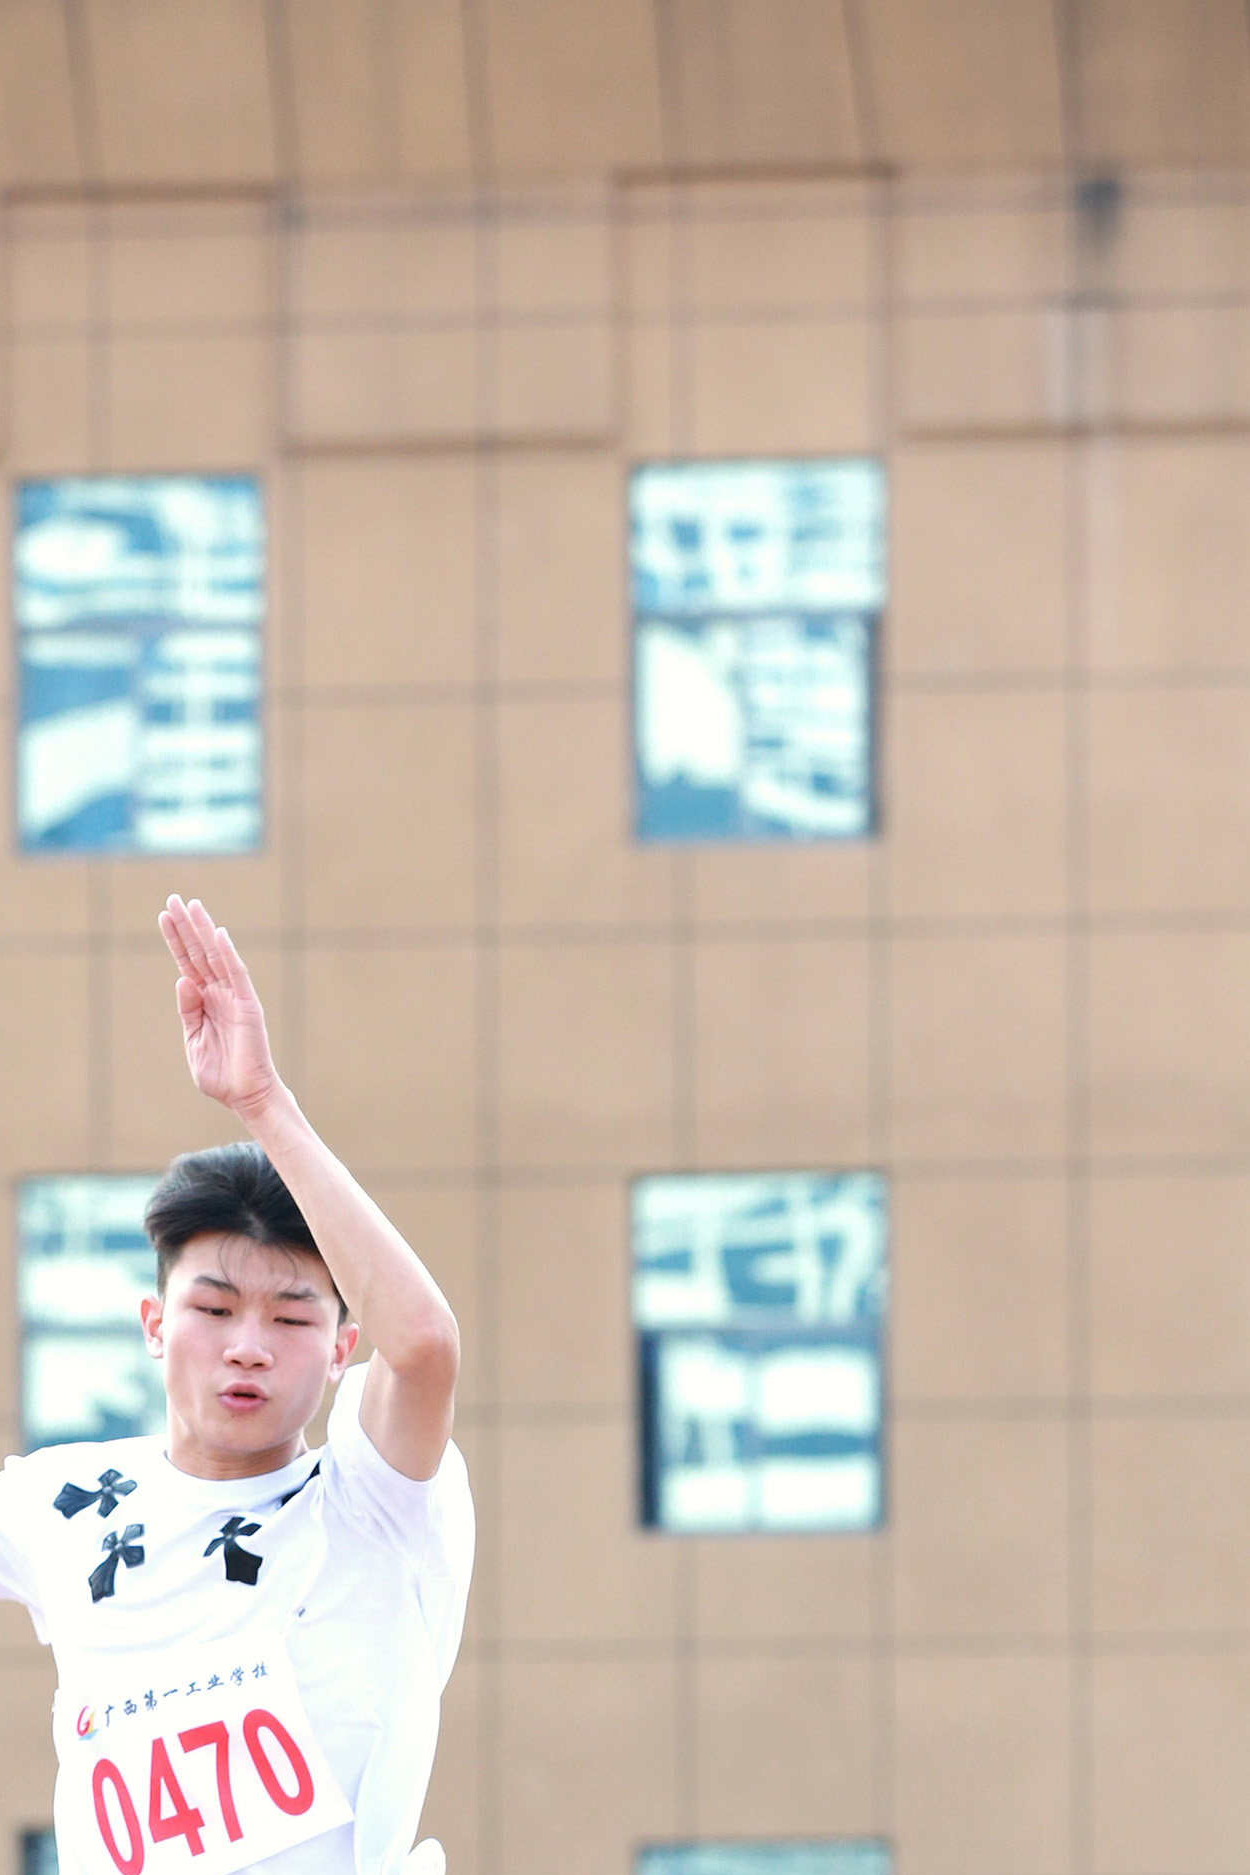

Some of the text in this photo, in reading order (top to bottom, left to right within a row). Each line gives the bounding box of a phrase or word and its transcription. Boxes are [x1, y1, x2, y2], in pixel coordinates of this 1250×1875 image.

[104, 1661, 269, 1728] 广西第一工业学校
